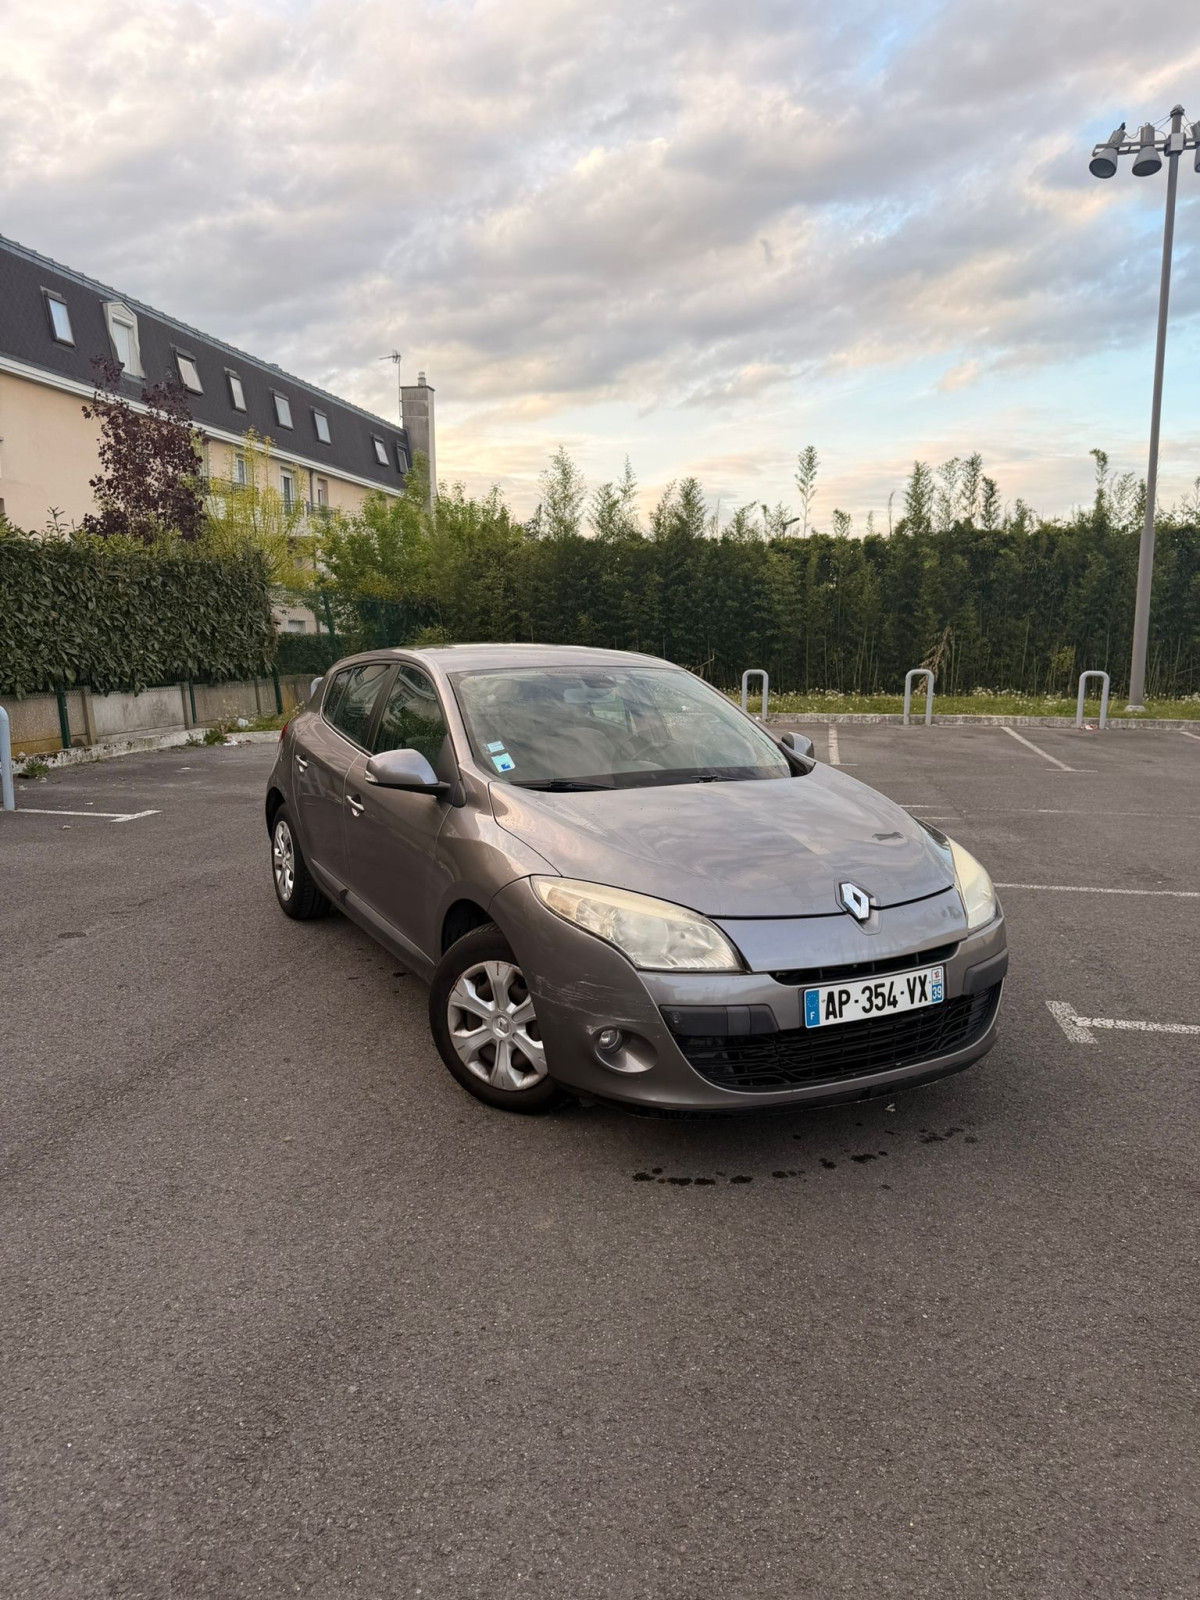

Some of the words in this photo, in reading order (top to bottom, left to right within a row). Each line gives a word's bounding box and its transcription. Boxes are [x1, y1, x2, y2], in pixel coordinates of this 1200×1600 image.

[825, 974, 928, 1020] AP-354-VX
[932, 985, 942, 999] 39
[810, 1011, 816, 1020] F
